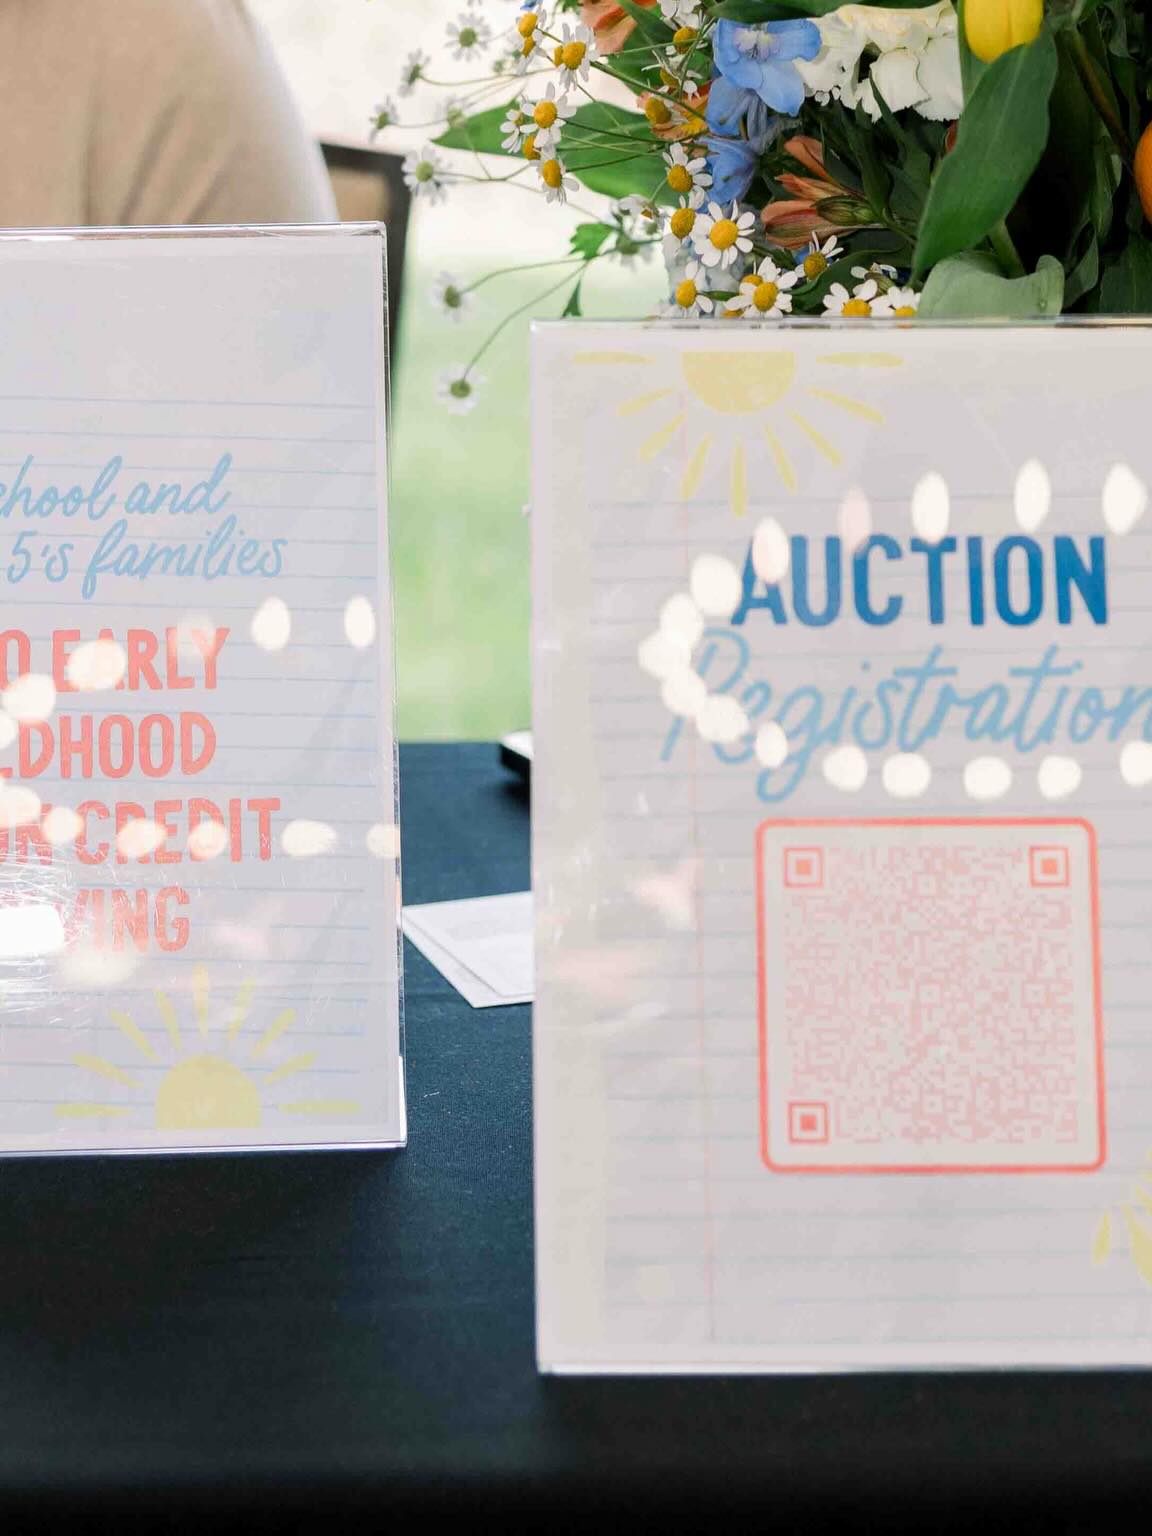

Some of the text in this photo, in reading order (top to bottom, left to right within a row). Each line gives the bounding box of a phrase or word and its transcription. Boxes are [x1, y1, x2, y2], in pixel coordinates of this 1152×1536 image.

[124, 452, 233, 515] and
[7, 514, 289, 600] 5's families
[730, 533, 1108, 628] AUCTION
[0, 711, 217, 779] DHOOD
[75, 797, 281, 866] CREDIT
